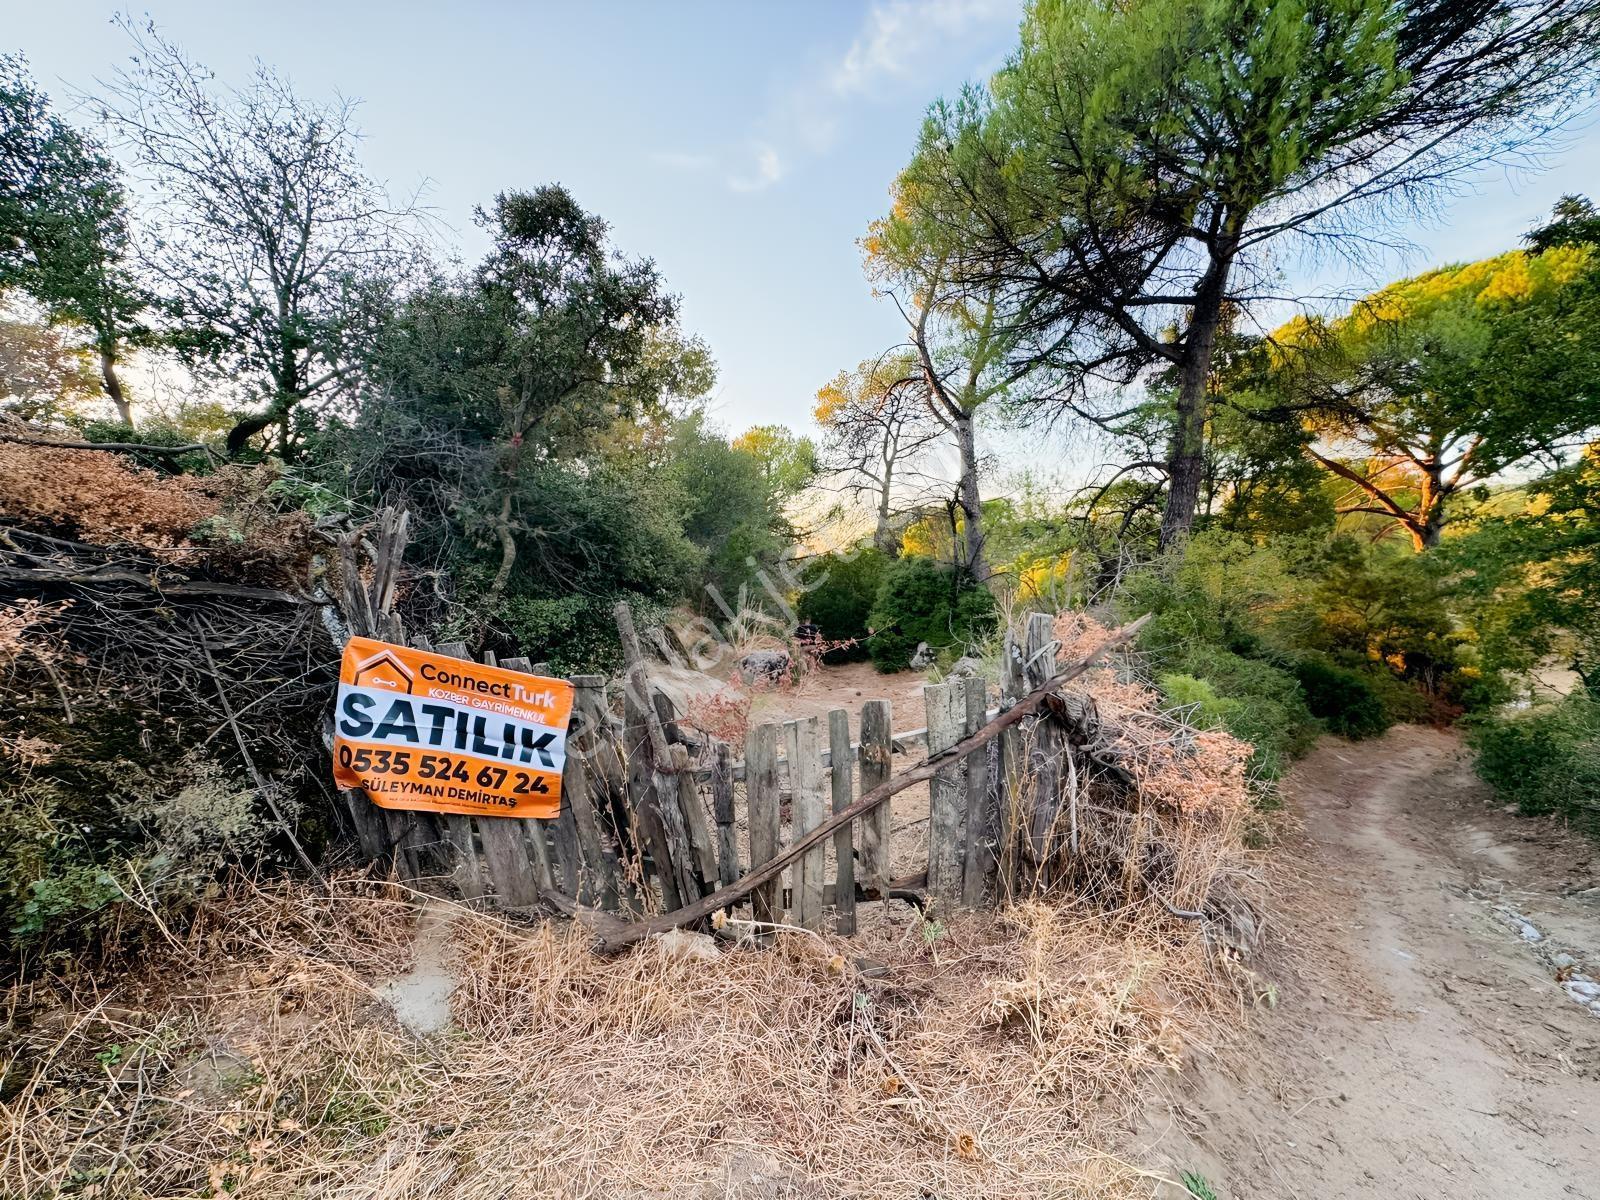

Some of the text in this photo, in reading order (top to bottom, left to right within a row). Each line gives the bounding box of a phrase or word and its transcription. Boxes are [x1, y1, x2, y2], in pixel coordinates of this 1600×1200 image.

[420, 663, 555, 708] ConnectTurk
[340, 692, 558, 768] SATILIK
[339, 744, 549, 795] 0535 524 67 24
[361, 777, 445, 798] SÜLEYMAN
[447, 786, 518, 808] DEMİRTAŞ
